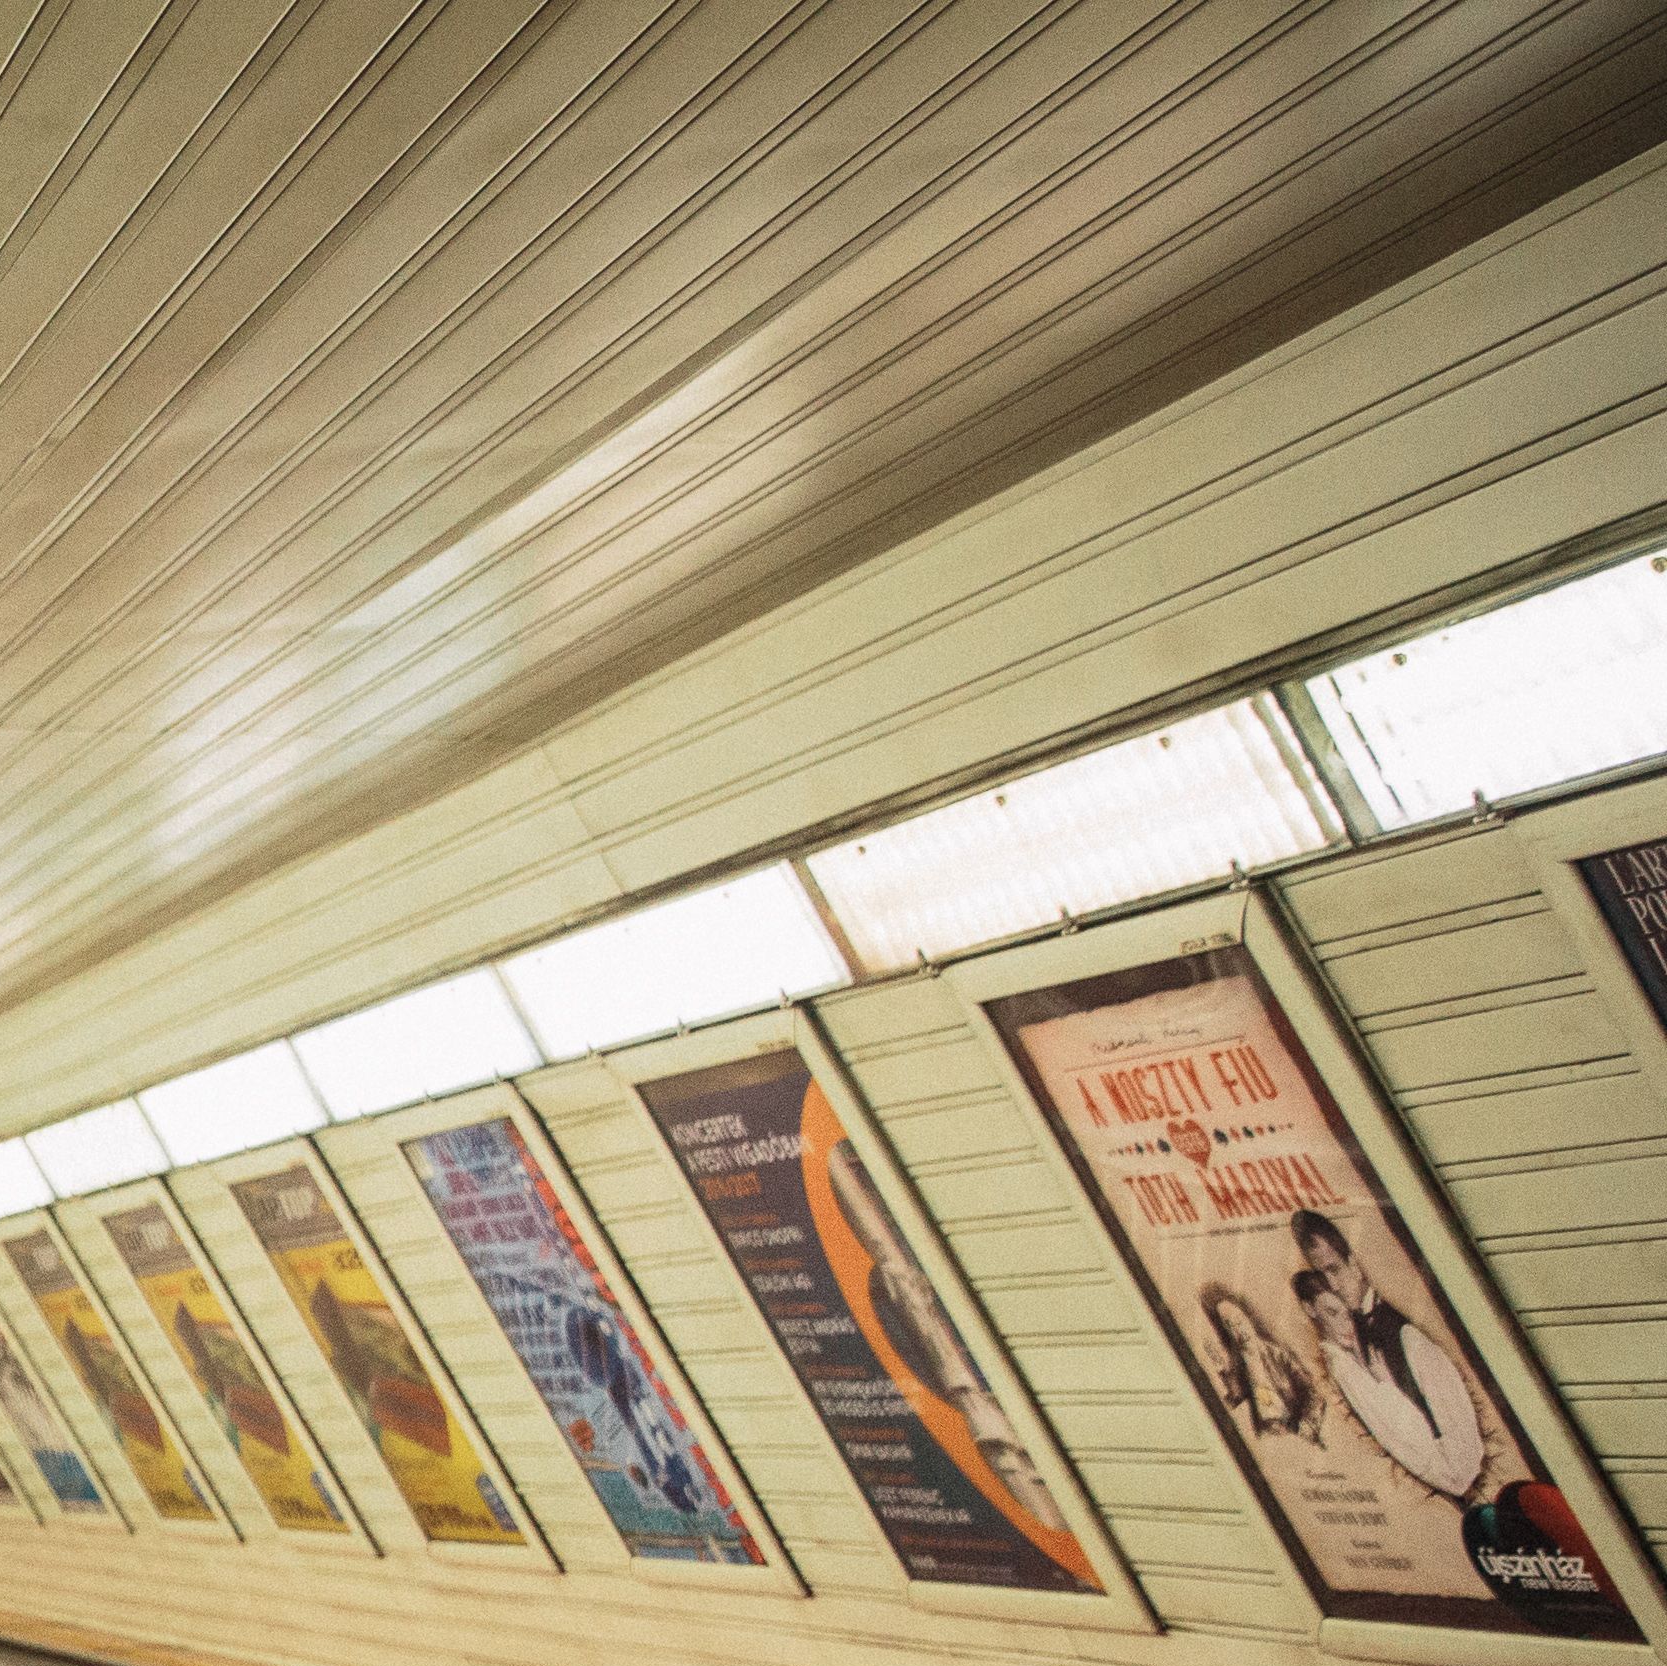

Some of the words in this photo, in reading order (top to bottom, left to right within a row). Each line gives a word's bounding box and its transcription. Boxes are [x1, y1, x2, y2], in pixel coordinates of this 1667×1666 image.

[1075, 1076, 1109, 1128] A
[1098, 1056, 1213, 1125] NOSZTY
[1190, 1152, 1348, 1221] MARIVAL
